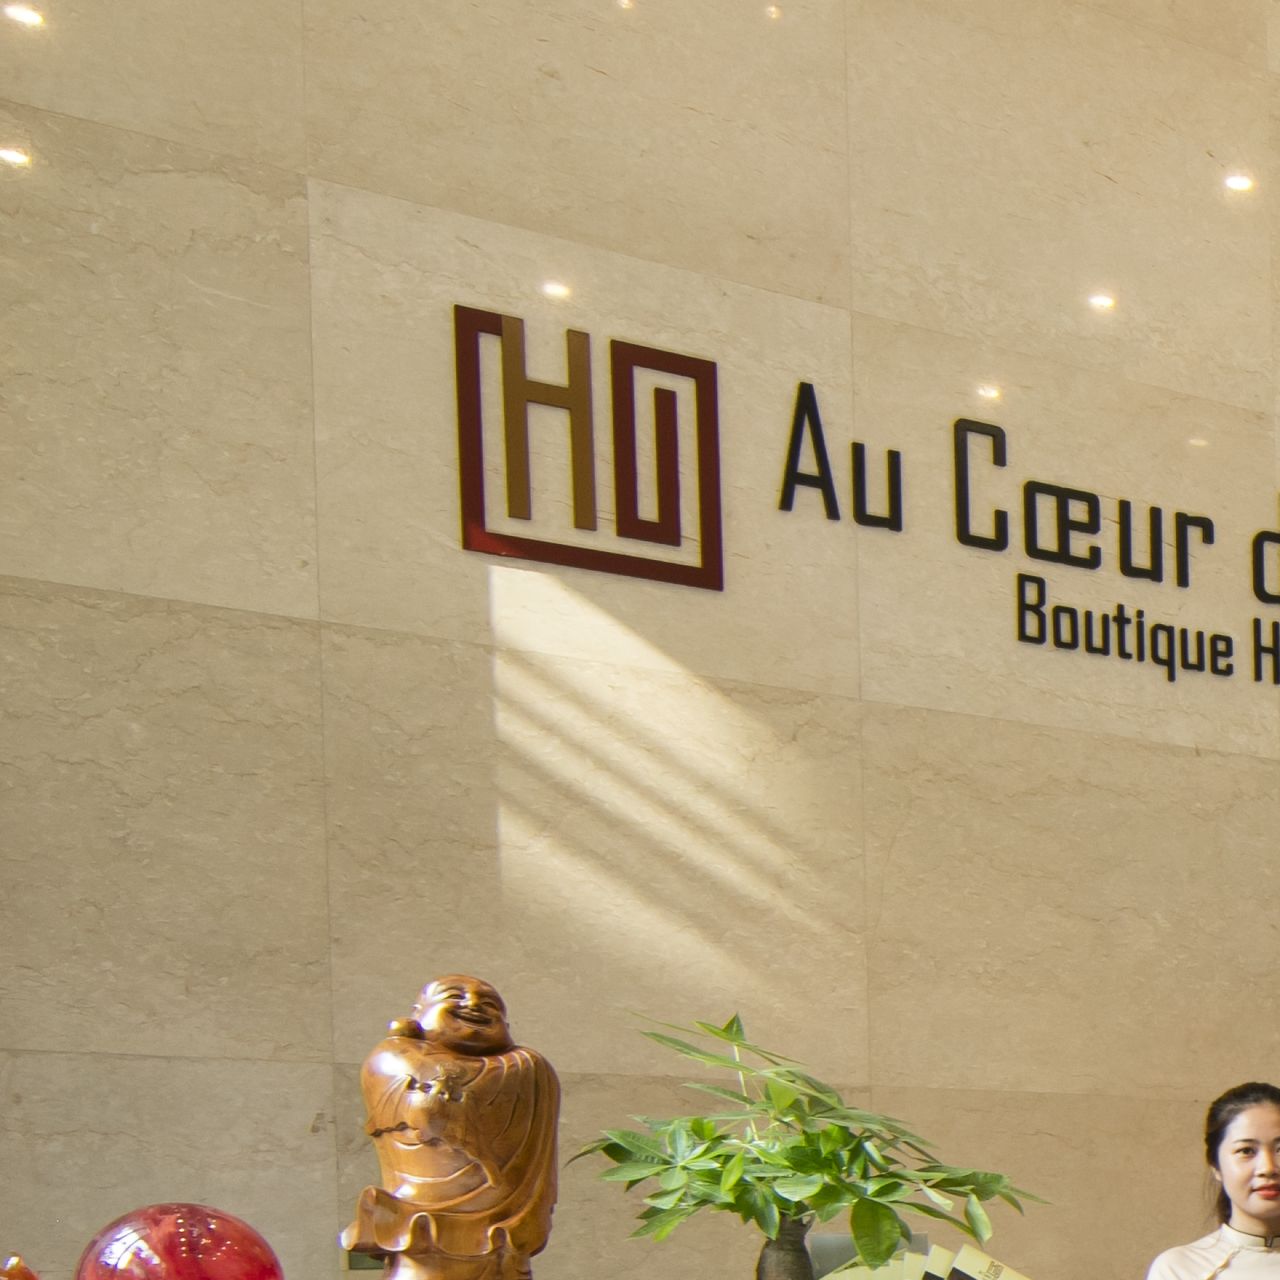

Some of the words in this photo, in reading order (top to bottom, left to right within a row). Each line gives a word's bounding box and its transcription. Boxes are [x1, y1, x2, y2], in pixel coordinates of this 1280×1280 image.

[777, 380, 904, 534] Au
[952, 417, 1216, 590] Cœur
[1016, 573, 1235, 684] Boutique
